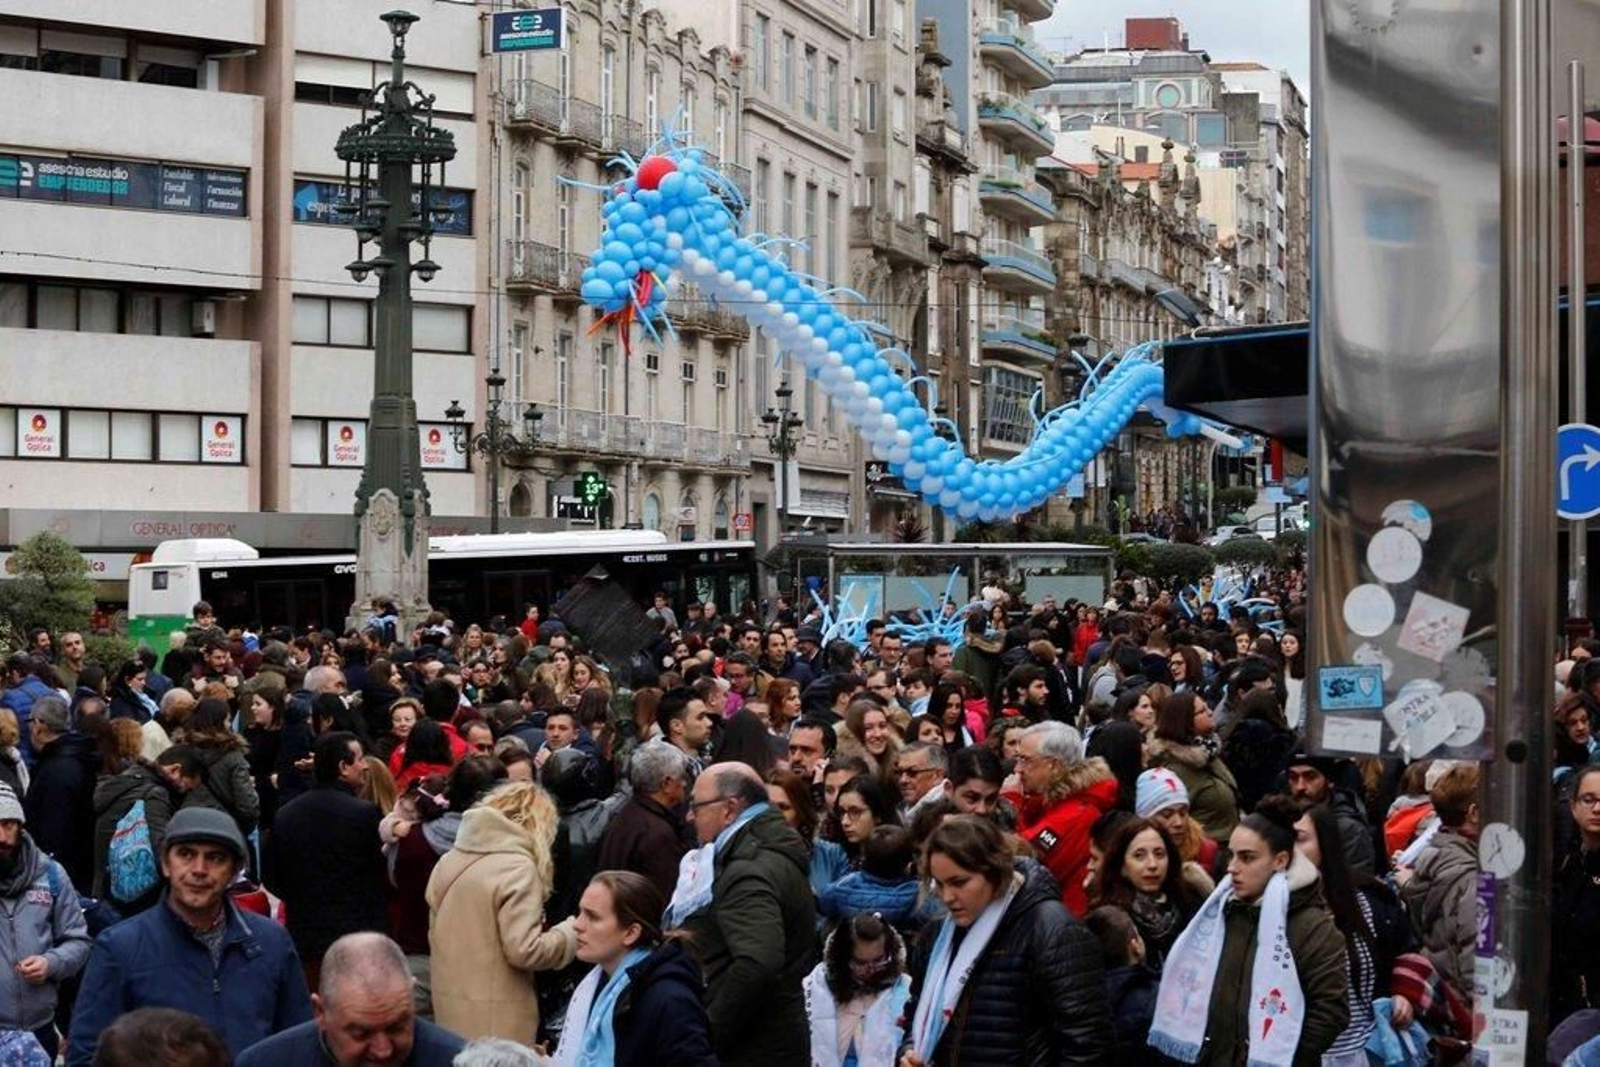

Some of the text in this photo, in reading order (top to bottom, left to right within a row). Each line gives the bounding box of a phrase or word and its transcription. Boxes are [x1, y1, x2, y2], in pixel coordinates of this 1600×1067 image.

[24, 433, 54, 442] General
[132, 522, 185, 536] GENERAL
[1040, 830, 1057, 846] HH
